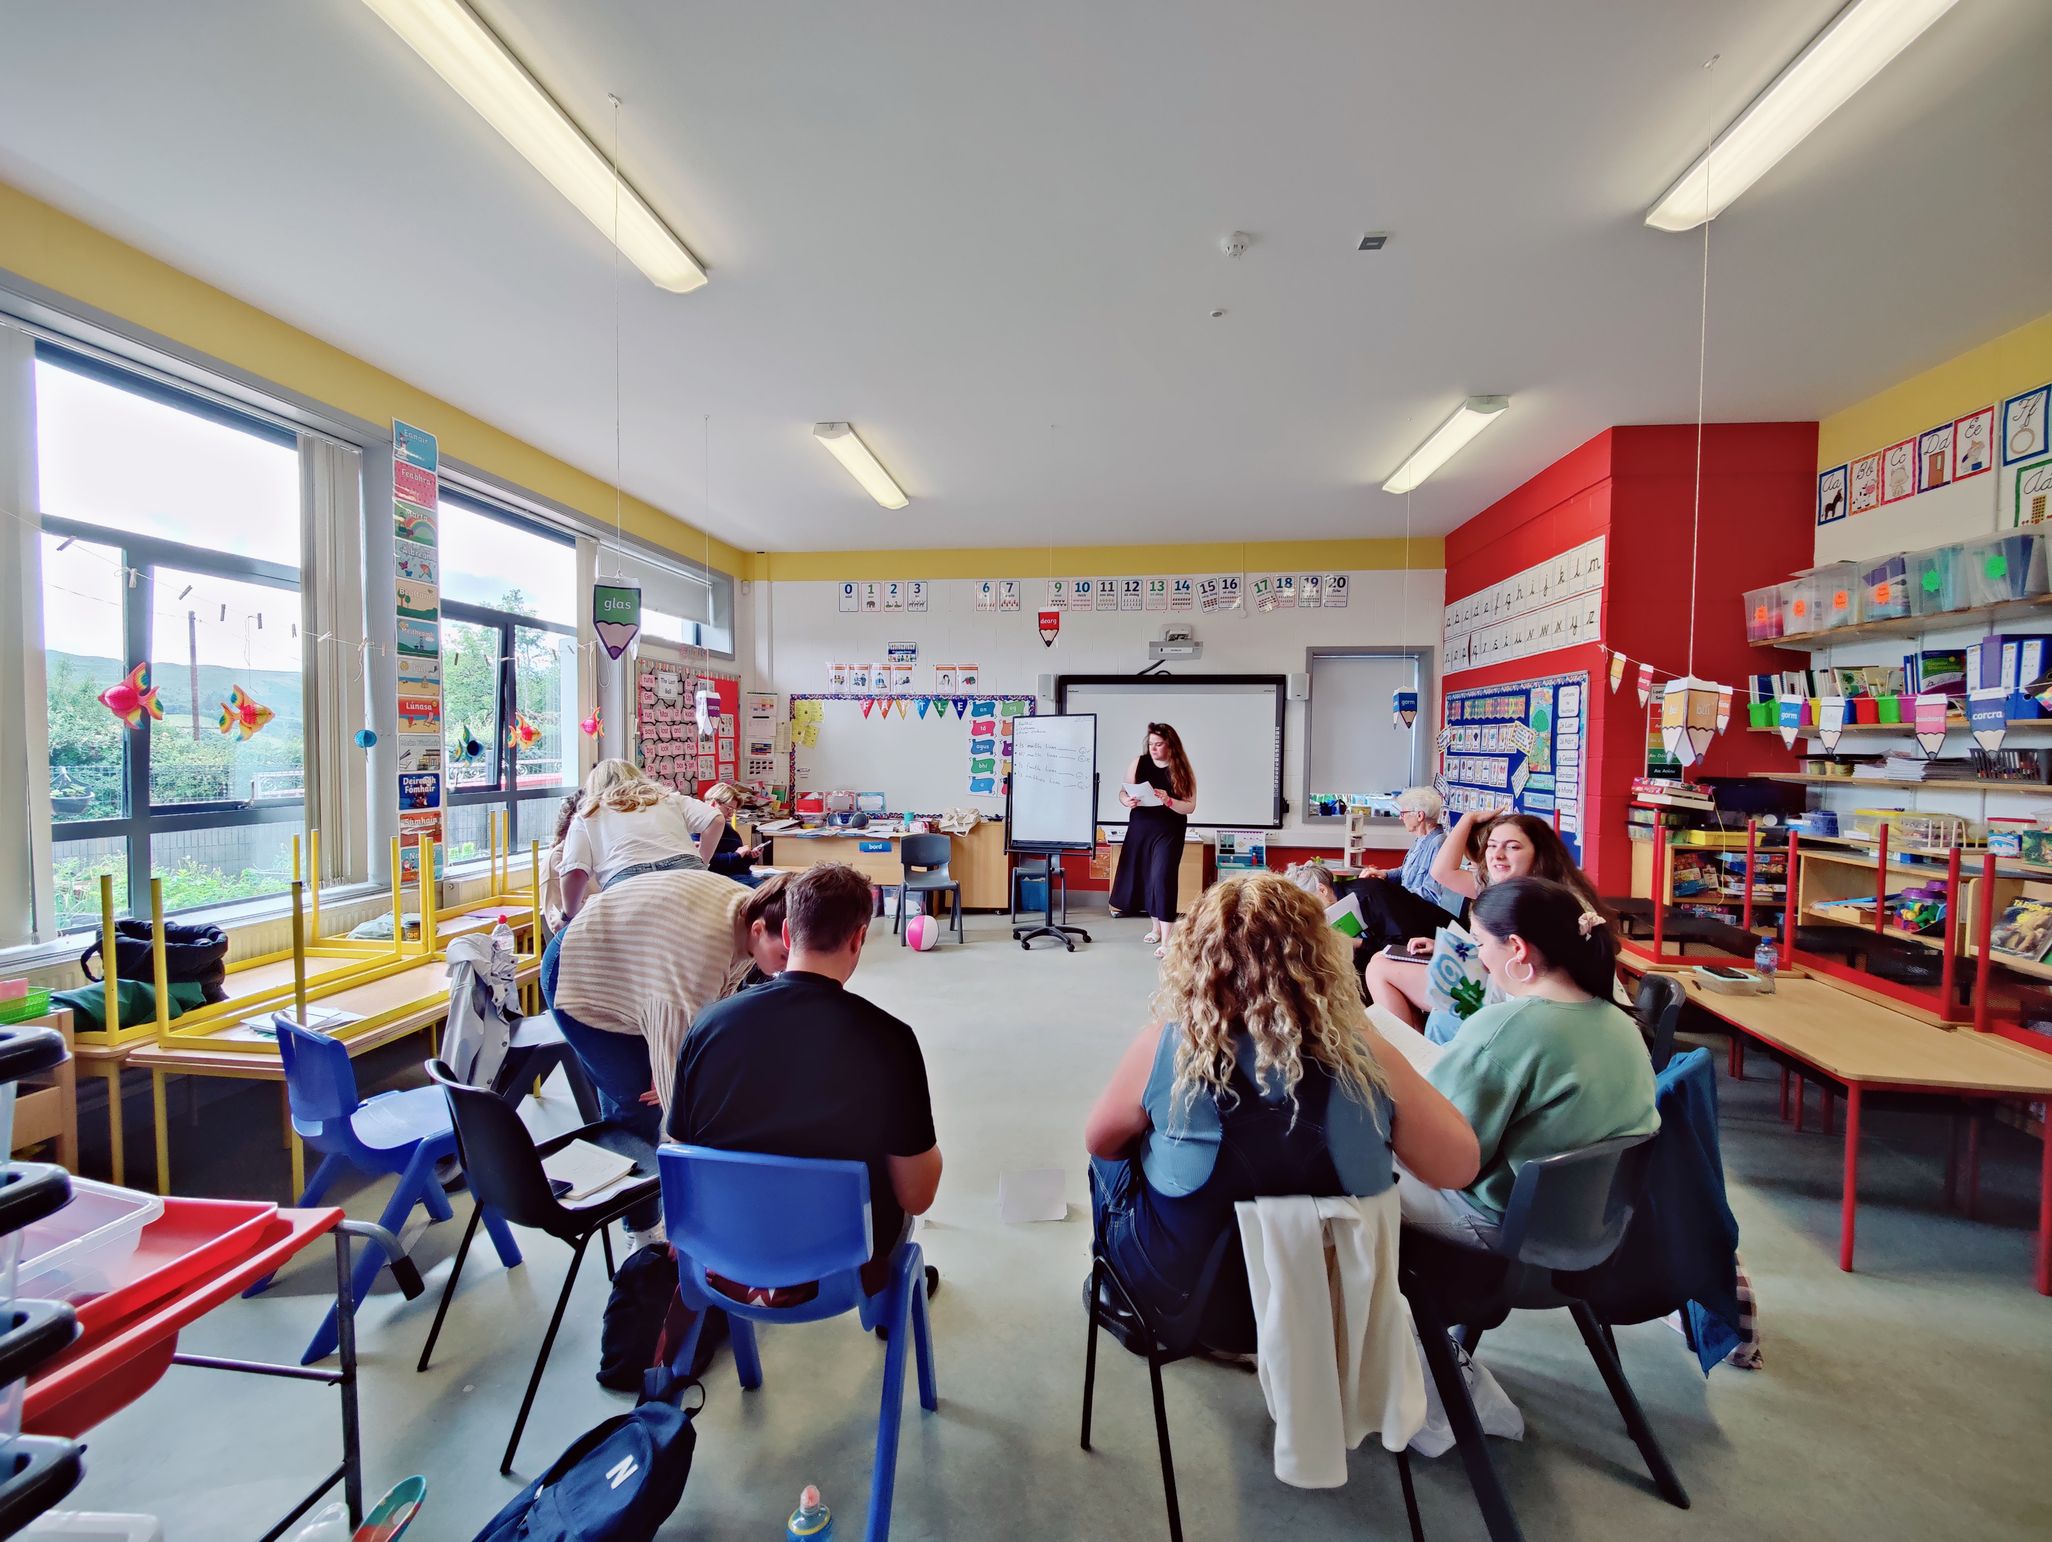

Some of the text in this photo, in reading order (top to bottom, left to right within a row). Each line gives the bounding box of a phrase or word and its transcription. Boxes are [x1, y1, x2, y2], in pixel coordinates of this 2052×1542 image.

[2012, 392, 2043, 427] Ff
[1964, 416, 1983, 439] Ee
[1923, 430, 1951, 456] Dd
[1891, 447, 1906, 467] Cc
[1856, 460, 1875, 481] Bb
[1822, 473, 1842, 492] Aa
[913, 583, 921, 594] 3
[982, 582, 990, 593] 6
[1006, 582, 1014, 594] 7
[1054, 582, 1062, 593] 9
[1074, 581, 1091, 593] 10
[1099, 581, 1115, 593] 11
[1124, 580, 1140, 593] 12
[1149, 580, 1165, 592] 13
[1174, 580, 1191, 592] 14
[1199, 582, 1216, 594] 15
[1222, 578, 1238, 590] 16
[1253, 579, 1269, 594] 17
[1276, 577, 1293, 589] 18
[1303, 577, 1319, 588] 19
[1328, 576, 1346, 589] 20
[844, 583, 853, 595] 0
[867, 583, 875, 595] 1
[890, 583, 898, 595] 2
[604, 597, 632, 611] glas
[1039, 617, 1057, 626] dearg
[406, 702, 432, 711] Lúnasa
[1781, 710, 1798, 721] gorm
[1972, 710, 2003, 720] corcra
[405, 785, 436, 795] Fómhair
[605, 1453, 639, 1491] N
